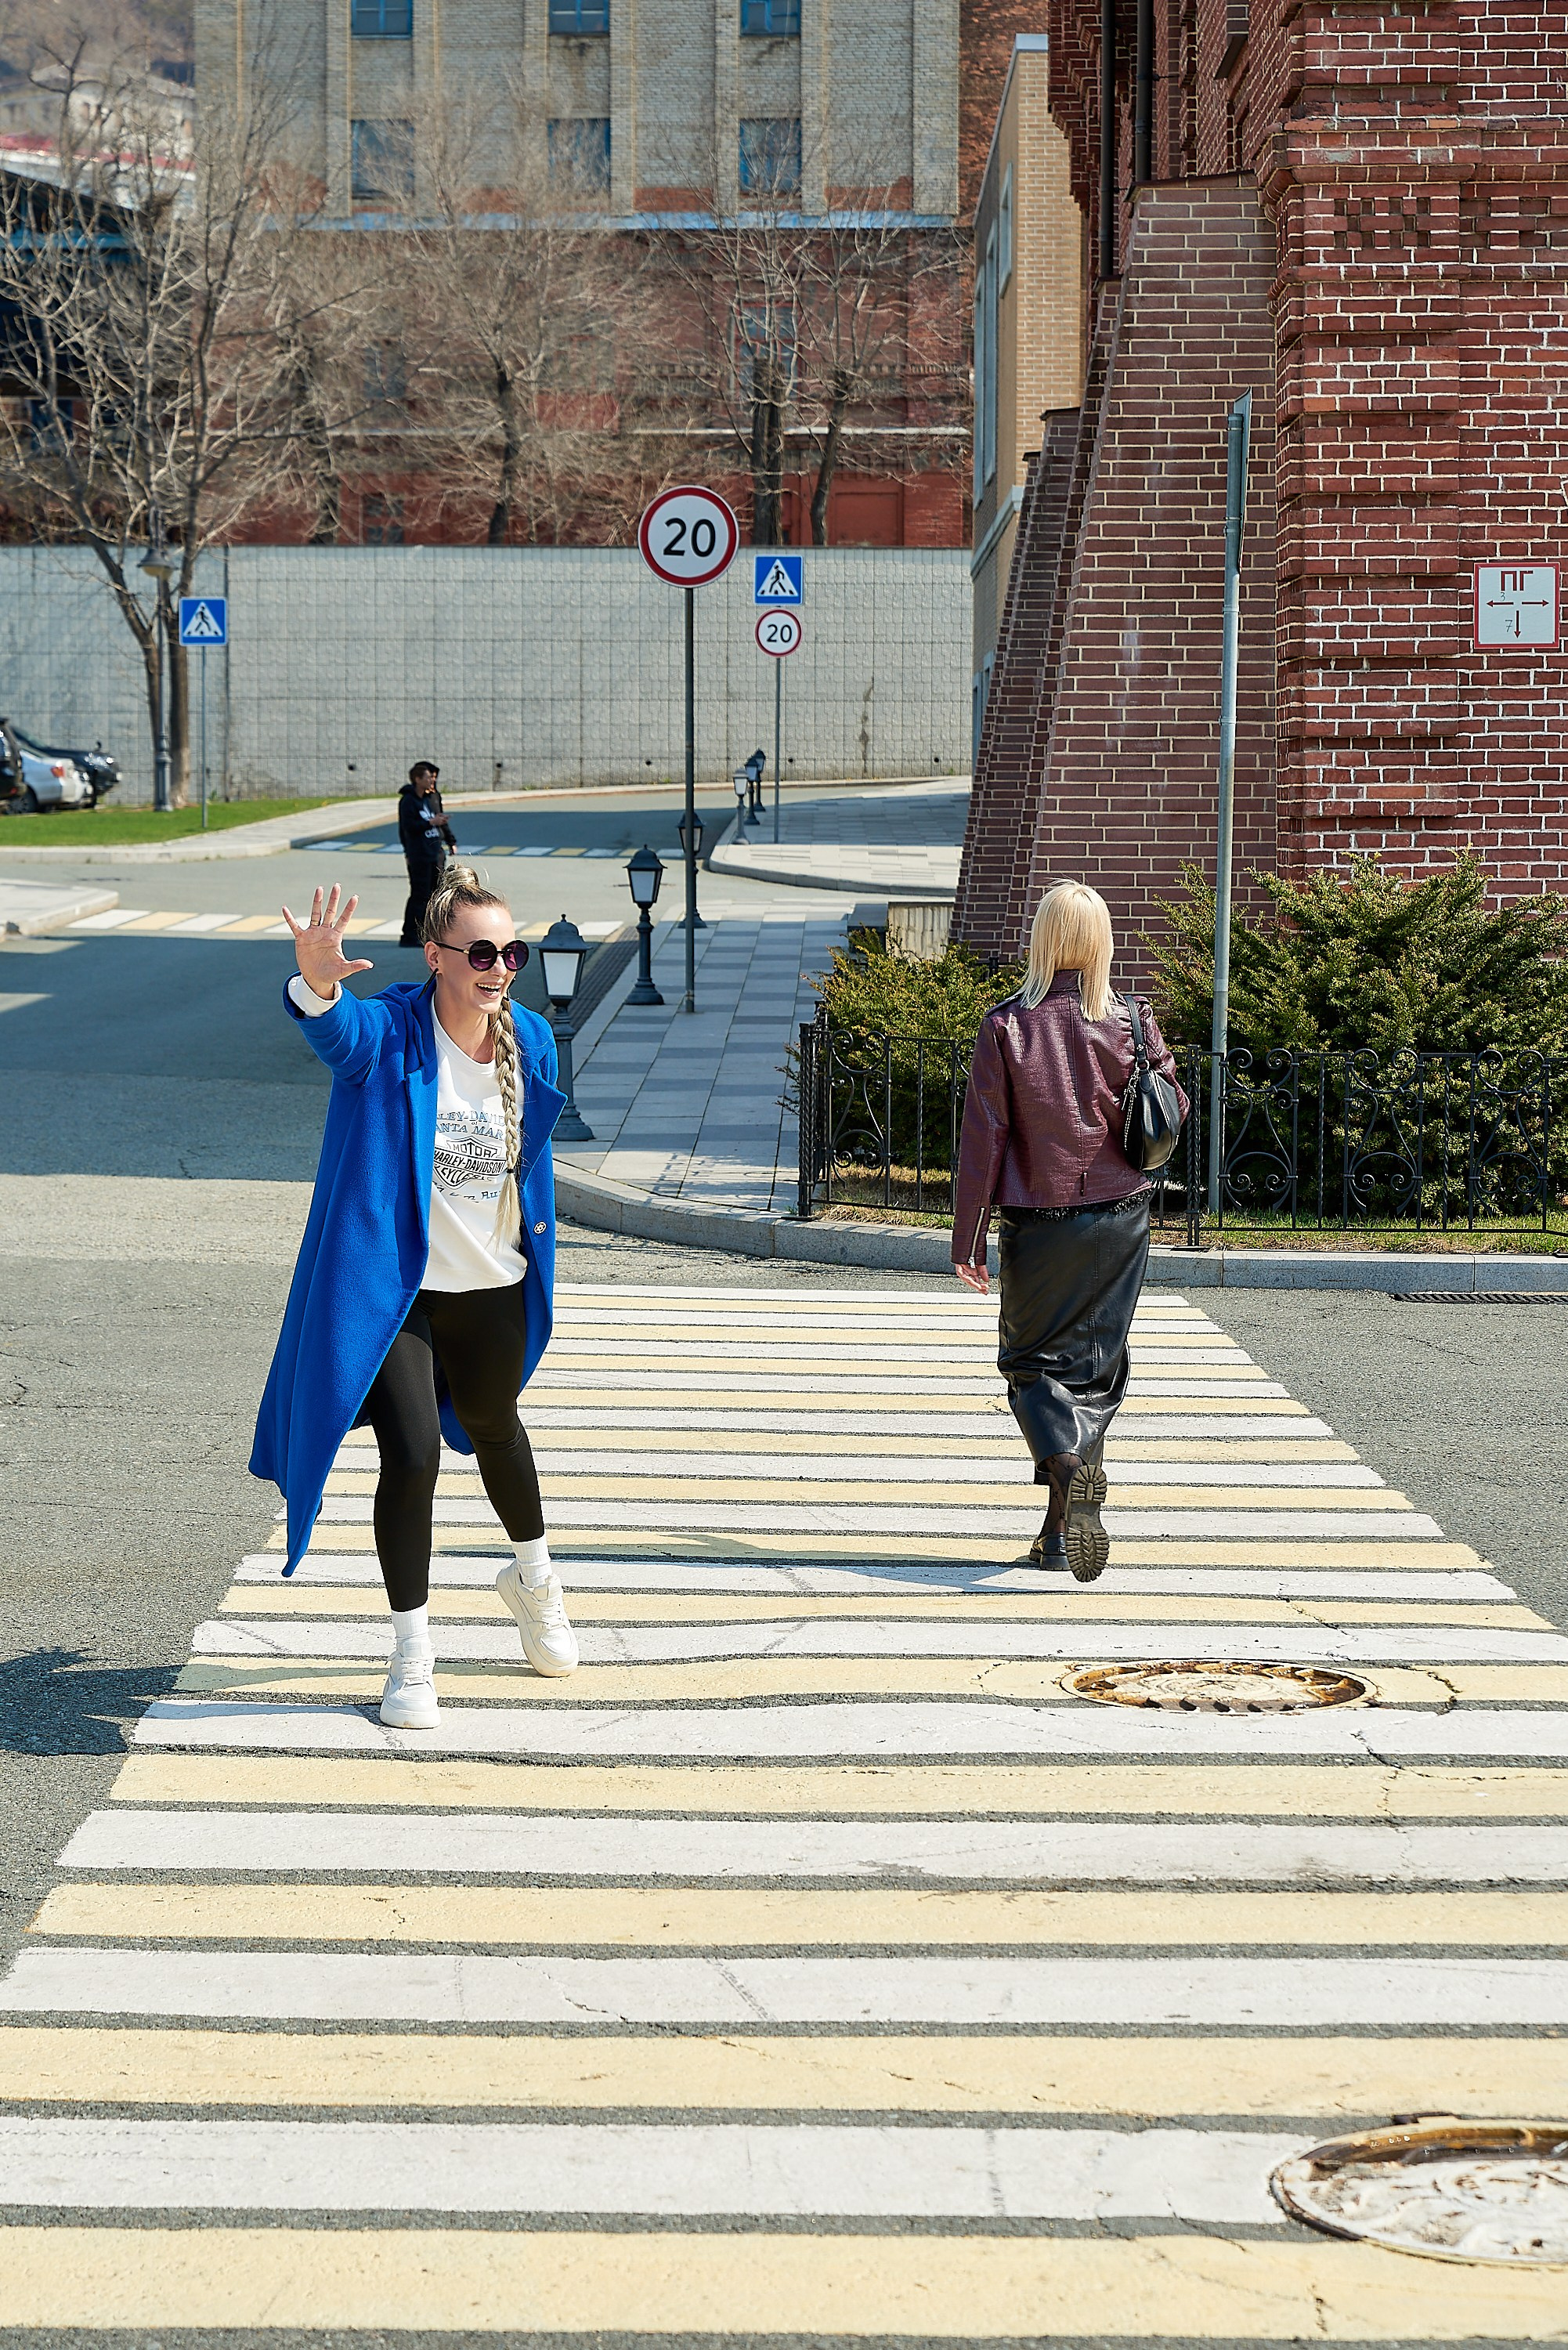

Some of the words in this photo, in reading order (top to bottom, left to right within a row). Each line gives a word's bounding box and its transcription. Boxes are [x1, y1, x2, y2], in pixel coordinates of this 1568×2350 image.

[663, 517, 716, 558] 20
[1501, 570, 1534, 591] ПГ
[1500, 591, 1505, 602] 3
[766, 624, 793, 643] 20
[1505, 619, 1513, 633] 7
[435, 1123, 468, 1133] ANTA
[471, 1126, 505, 1141] MAR
[453, 1142, 491, 1158] MOTOR
[434, 1150, 503, 1173] HARLEY-DAVIDSON
